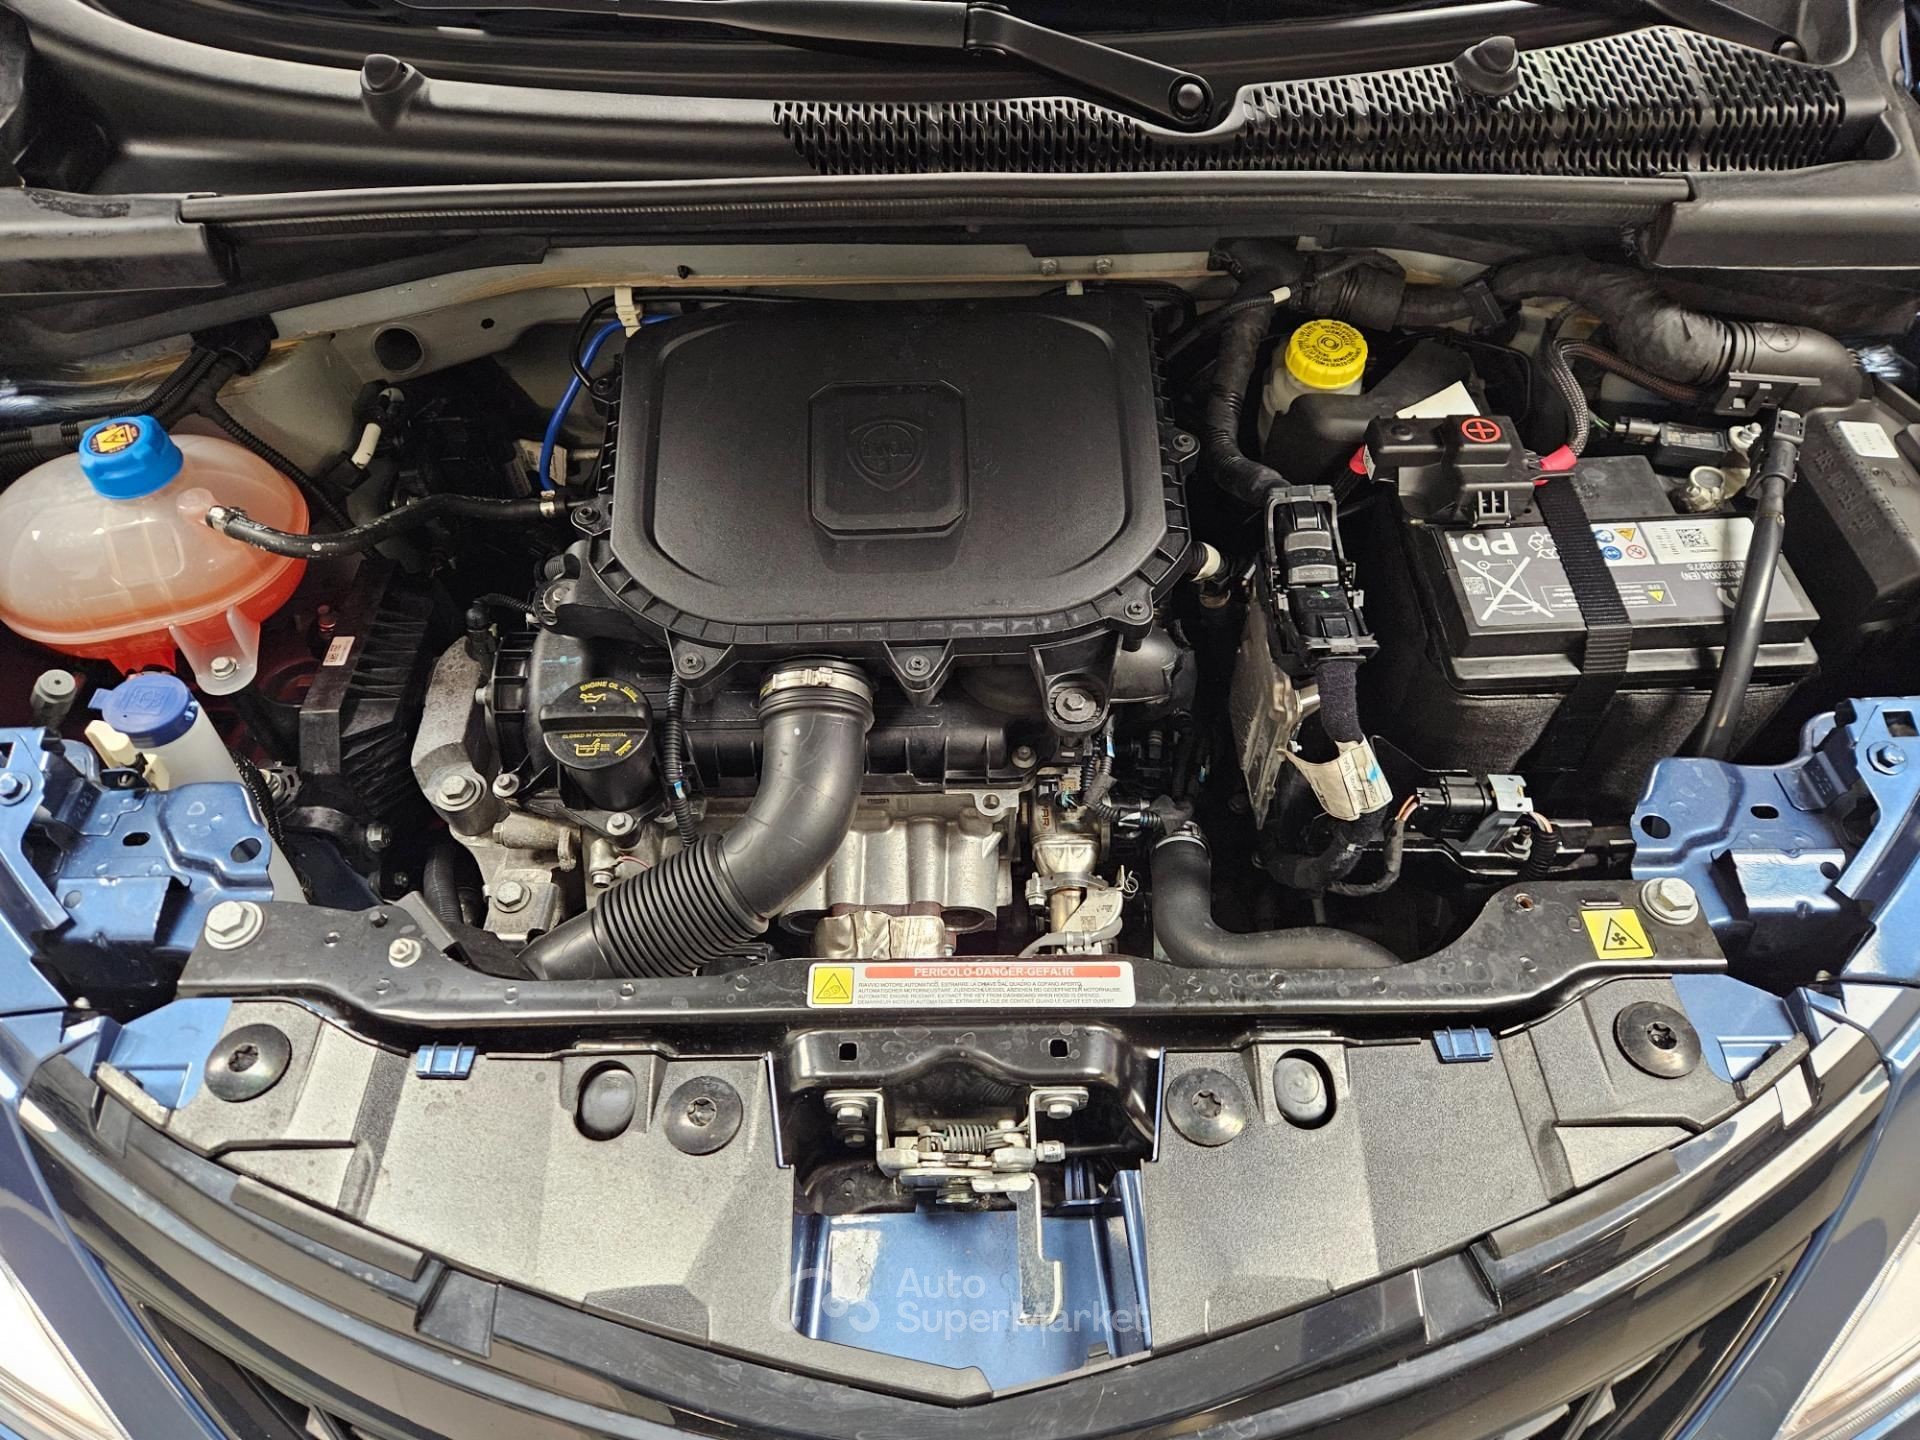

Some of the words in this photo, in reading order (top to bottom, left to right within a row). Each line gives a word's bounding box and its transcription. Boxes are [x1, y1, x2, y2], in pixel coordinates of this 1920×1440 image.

[1462, 531, 1520, 556] Pb
[579, 680, 608, 692] ENGINE
[608, 681, 619, 691] OIL
